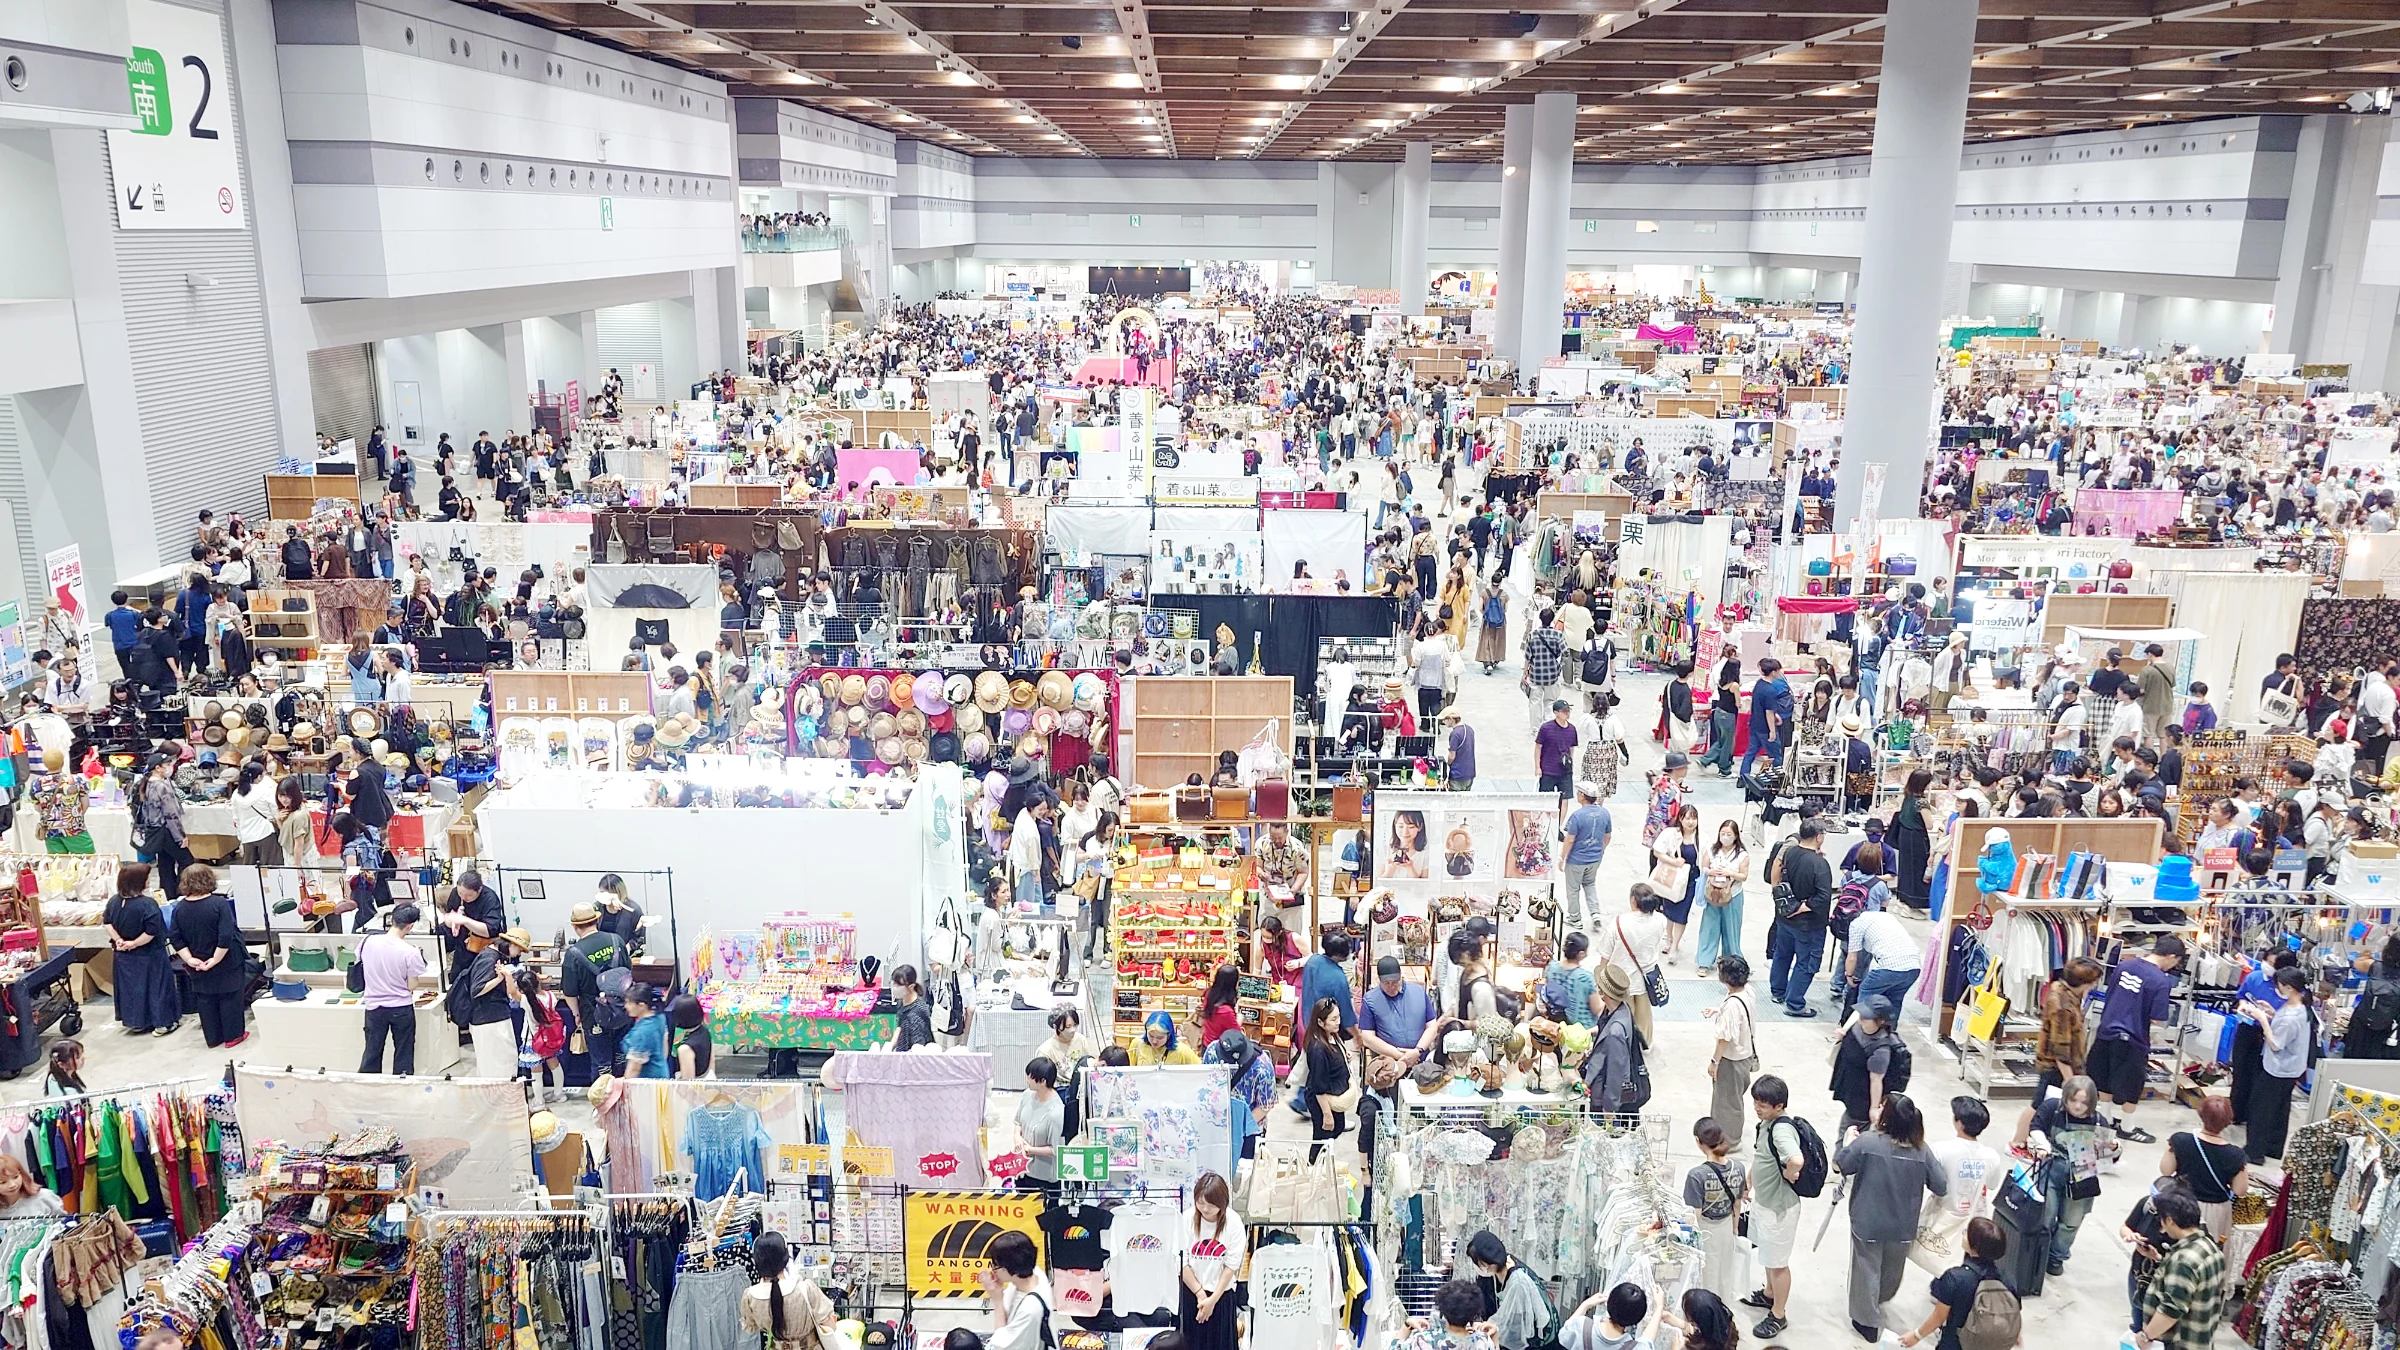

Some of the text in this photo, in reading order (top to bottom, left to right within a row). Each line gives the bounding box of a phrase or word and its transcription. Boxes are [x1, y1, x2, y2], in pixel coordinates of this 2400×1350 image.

[127, 57, 155, 75] South
[132, 79, 160, 128] 南
[182, 55, 219, 140] 2
[1127, 412, 1143, 490] 着る山菜。
[1166, 483, 1227, 497] 着る山菜。
[1621, 520, 1644, 545] 栗
[48, 551, 79, 567] DESIGN FESTA
[2073, 548, 2114, 562] Factory
[921, 1161, 955, 1171] STOP!
[925, 1202, 1025, 1219] WARNING
